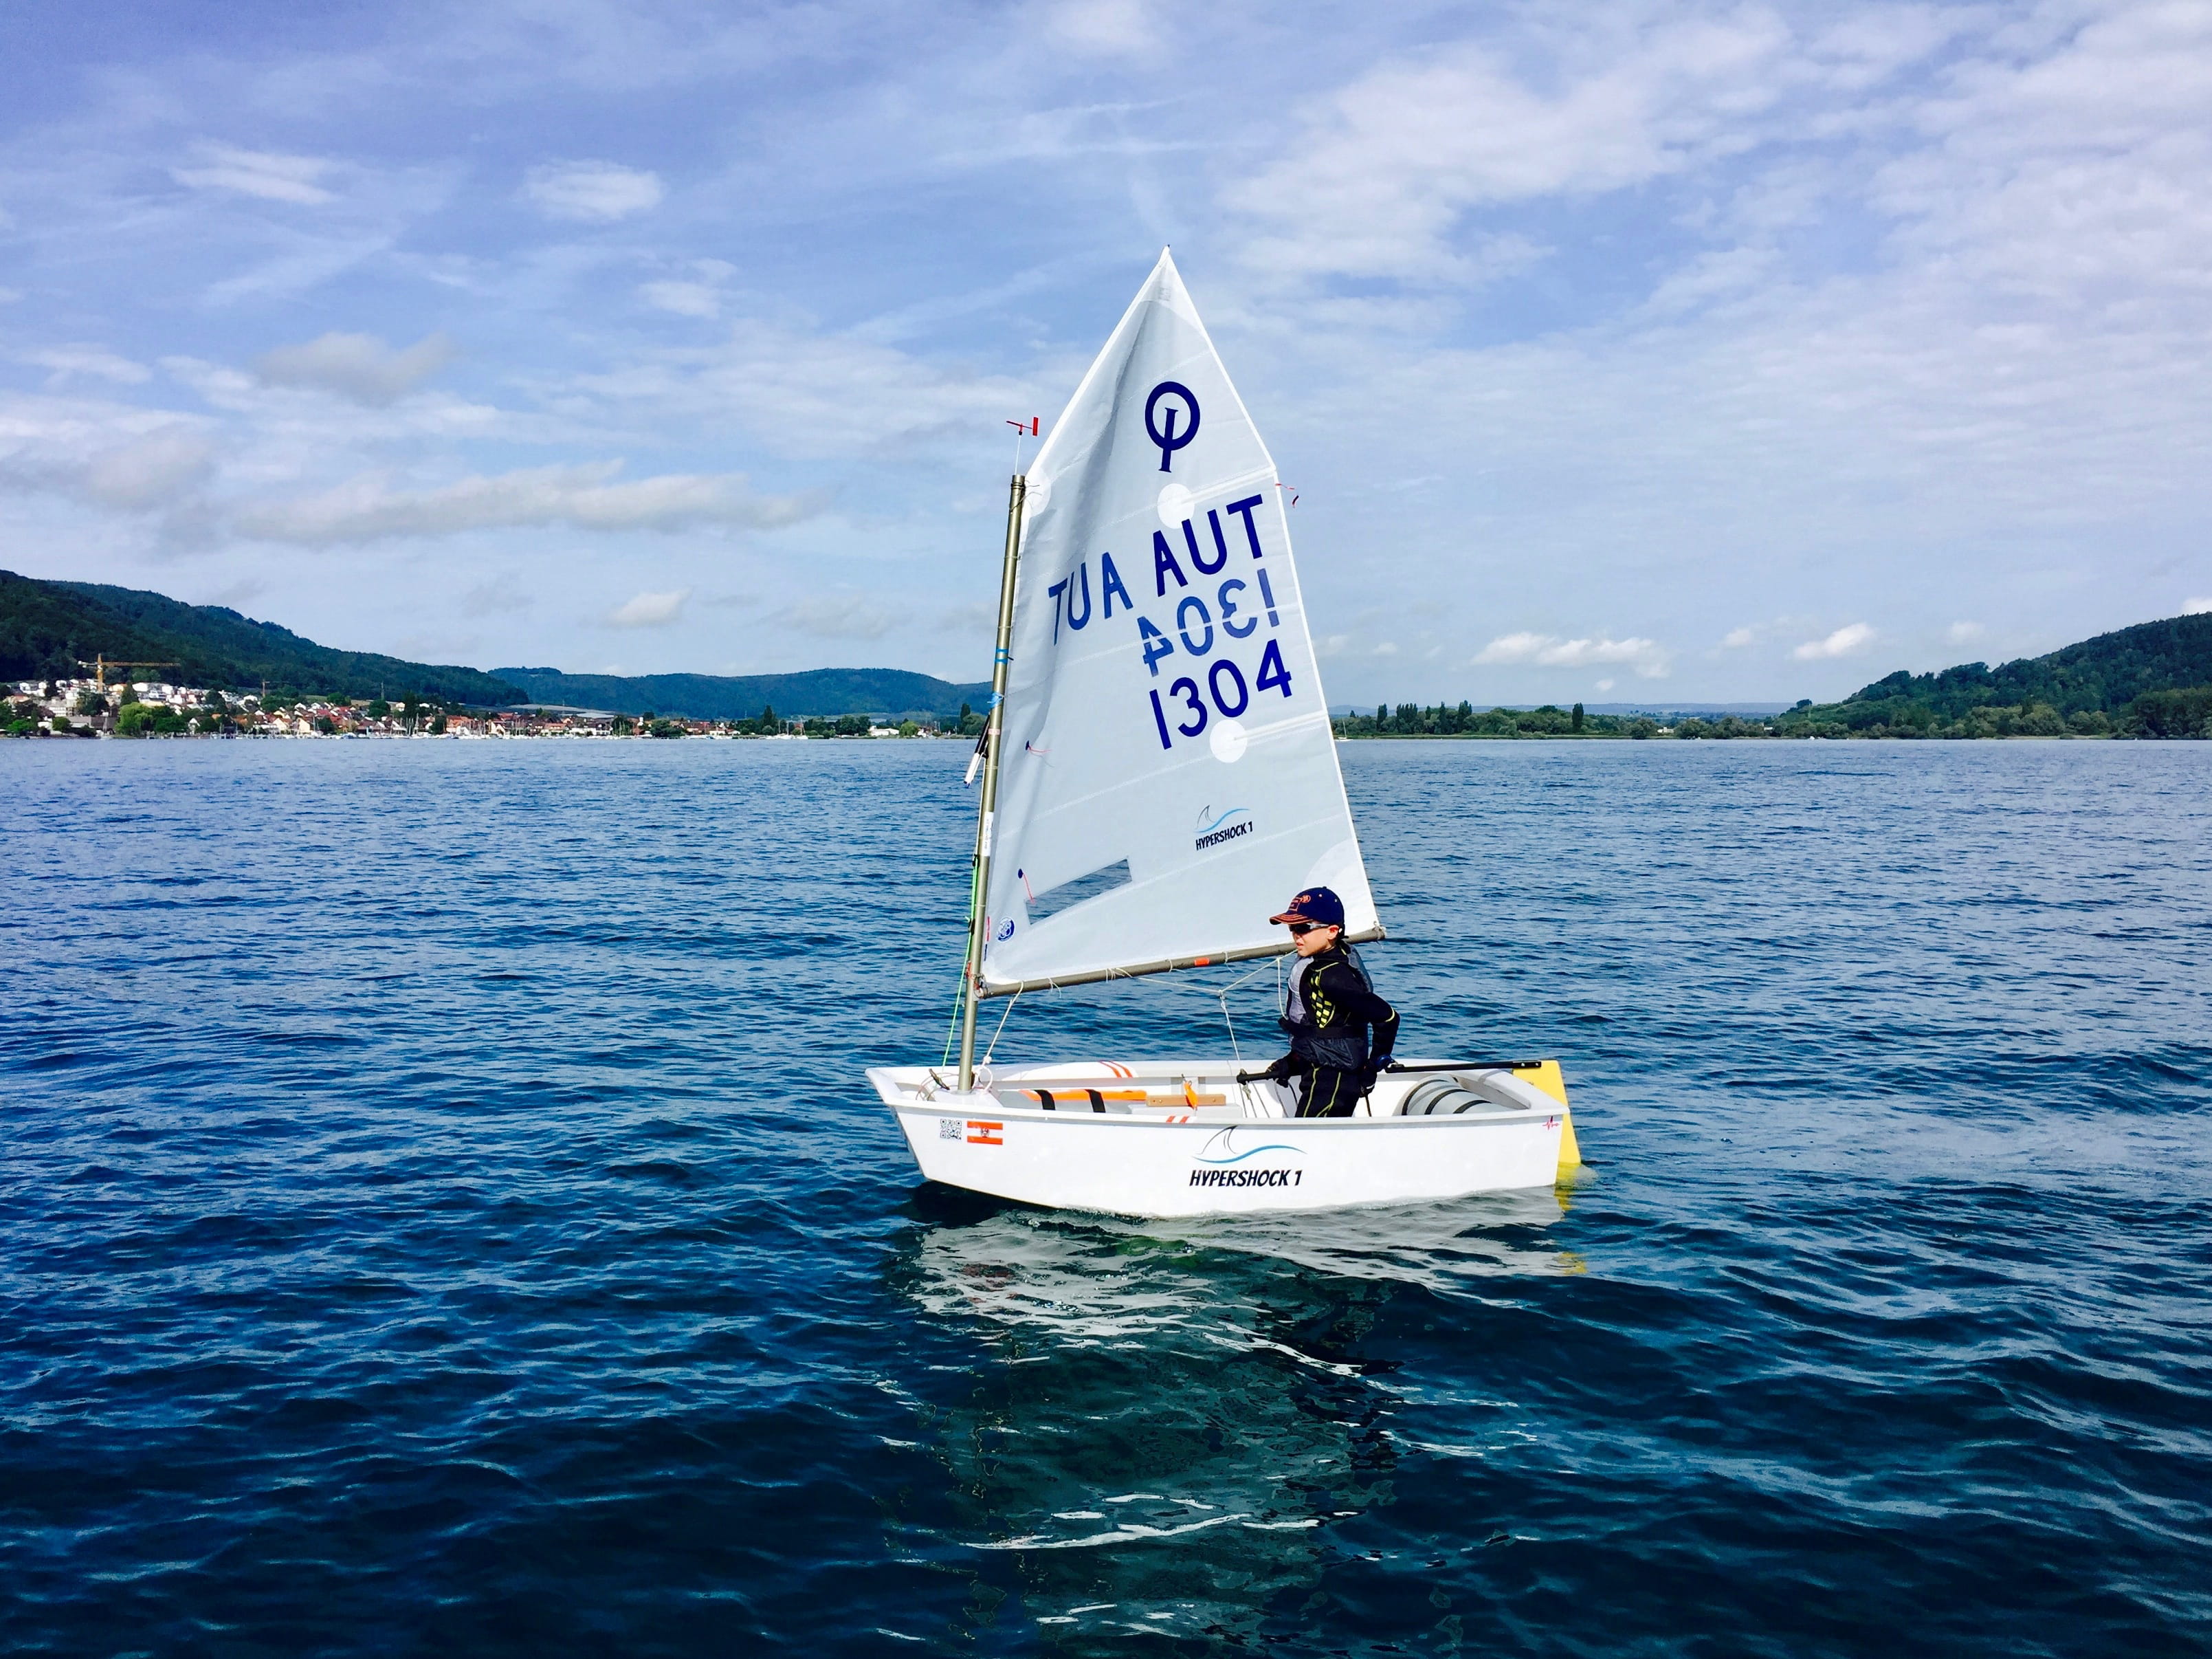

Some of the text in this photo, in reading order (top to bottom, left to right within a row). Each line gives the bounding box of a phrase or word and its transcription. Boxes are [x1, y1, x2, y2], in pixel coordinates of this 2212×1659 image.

[1153, 494, 1263, 597] AUT
[1149, 638, 1292, 750] 1304
[1195, 820, 1253, 851] HYPERSHOCK 1
[1189, 1169, 1303, 1187] HYPERSHOCK 1
